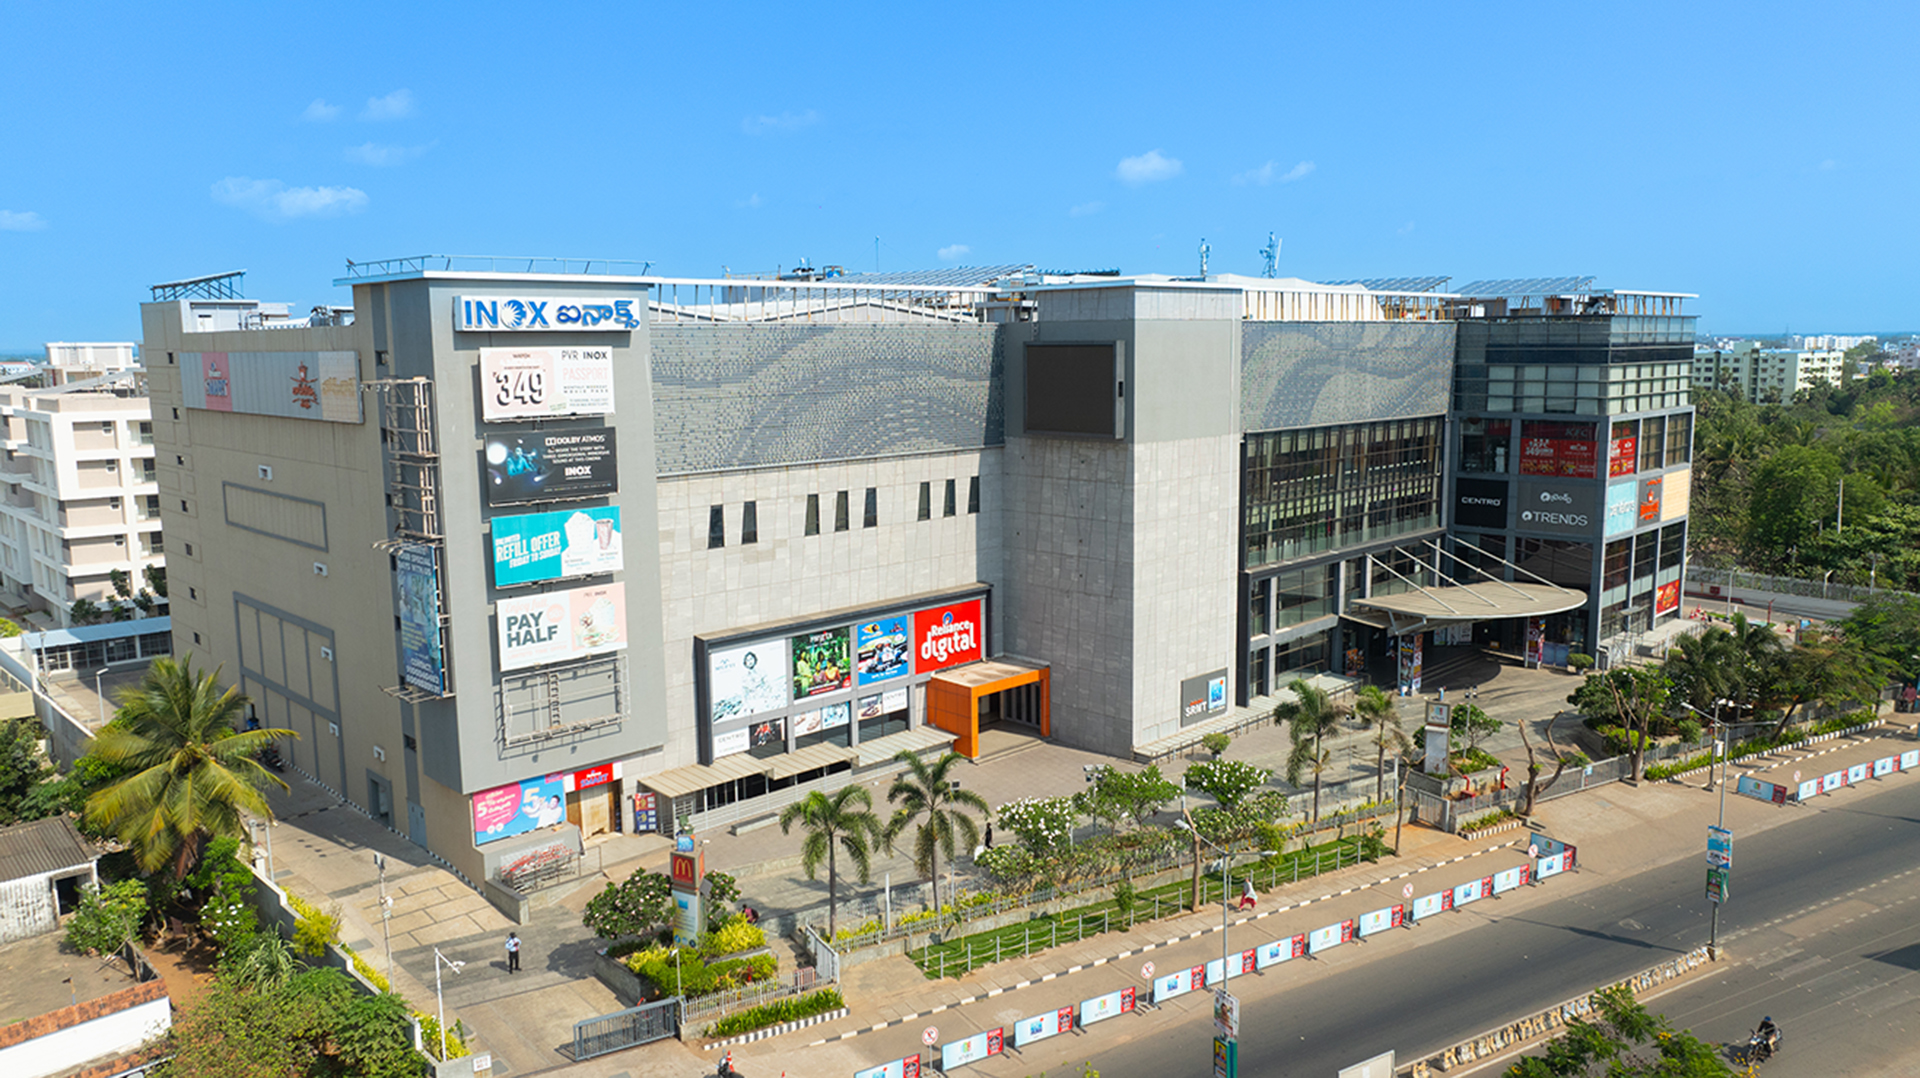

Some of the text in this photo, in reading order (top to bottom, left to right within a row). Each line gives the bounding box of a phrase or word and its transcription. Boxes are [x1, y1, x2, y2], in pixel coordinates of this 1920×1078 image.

[464, 299, 549, 328] INOX
[561, 350, 608, 360] PVR INOX
[562, 367, 608, 380] PASSPORT
[557, 434, 606, 444] DOLBY ATMOS
[1565, 427, 1588, 437] KFC
[564, 465, 592, 476] INOX
[1461, 496, 1500, 507] CENTRO
[1532, 510, 1588, 526] TRENDS
[496, 530, 560, 562] REFILL OFFER
[506, 611, 544, 632] PAY
[931, 620, 971, 637] Reliance
[507, 625, 558, 648] HALF
[921, 622, 976, 662] digital
